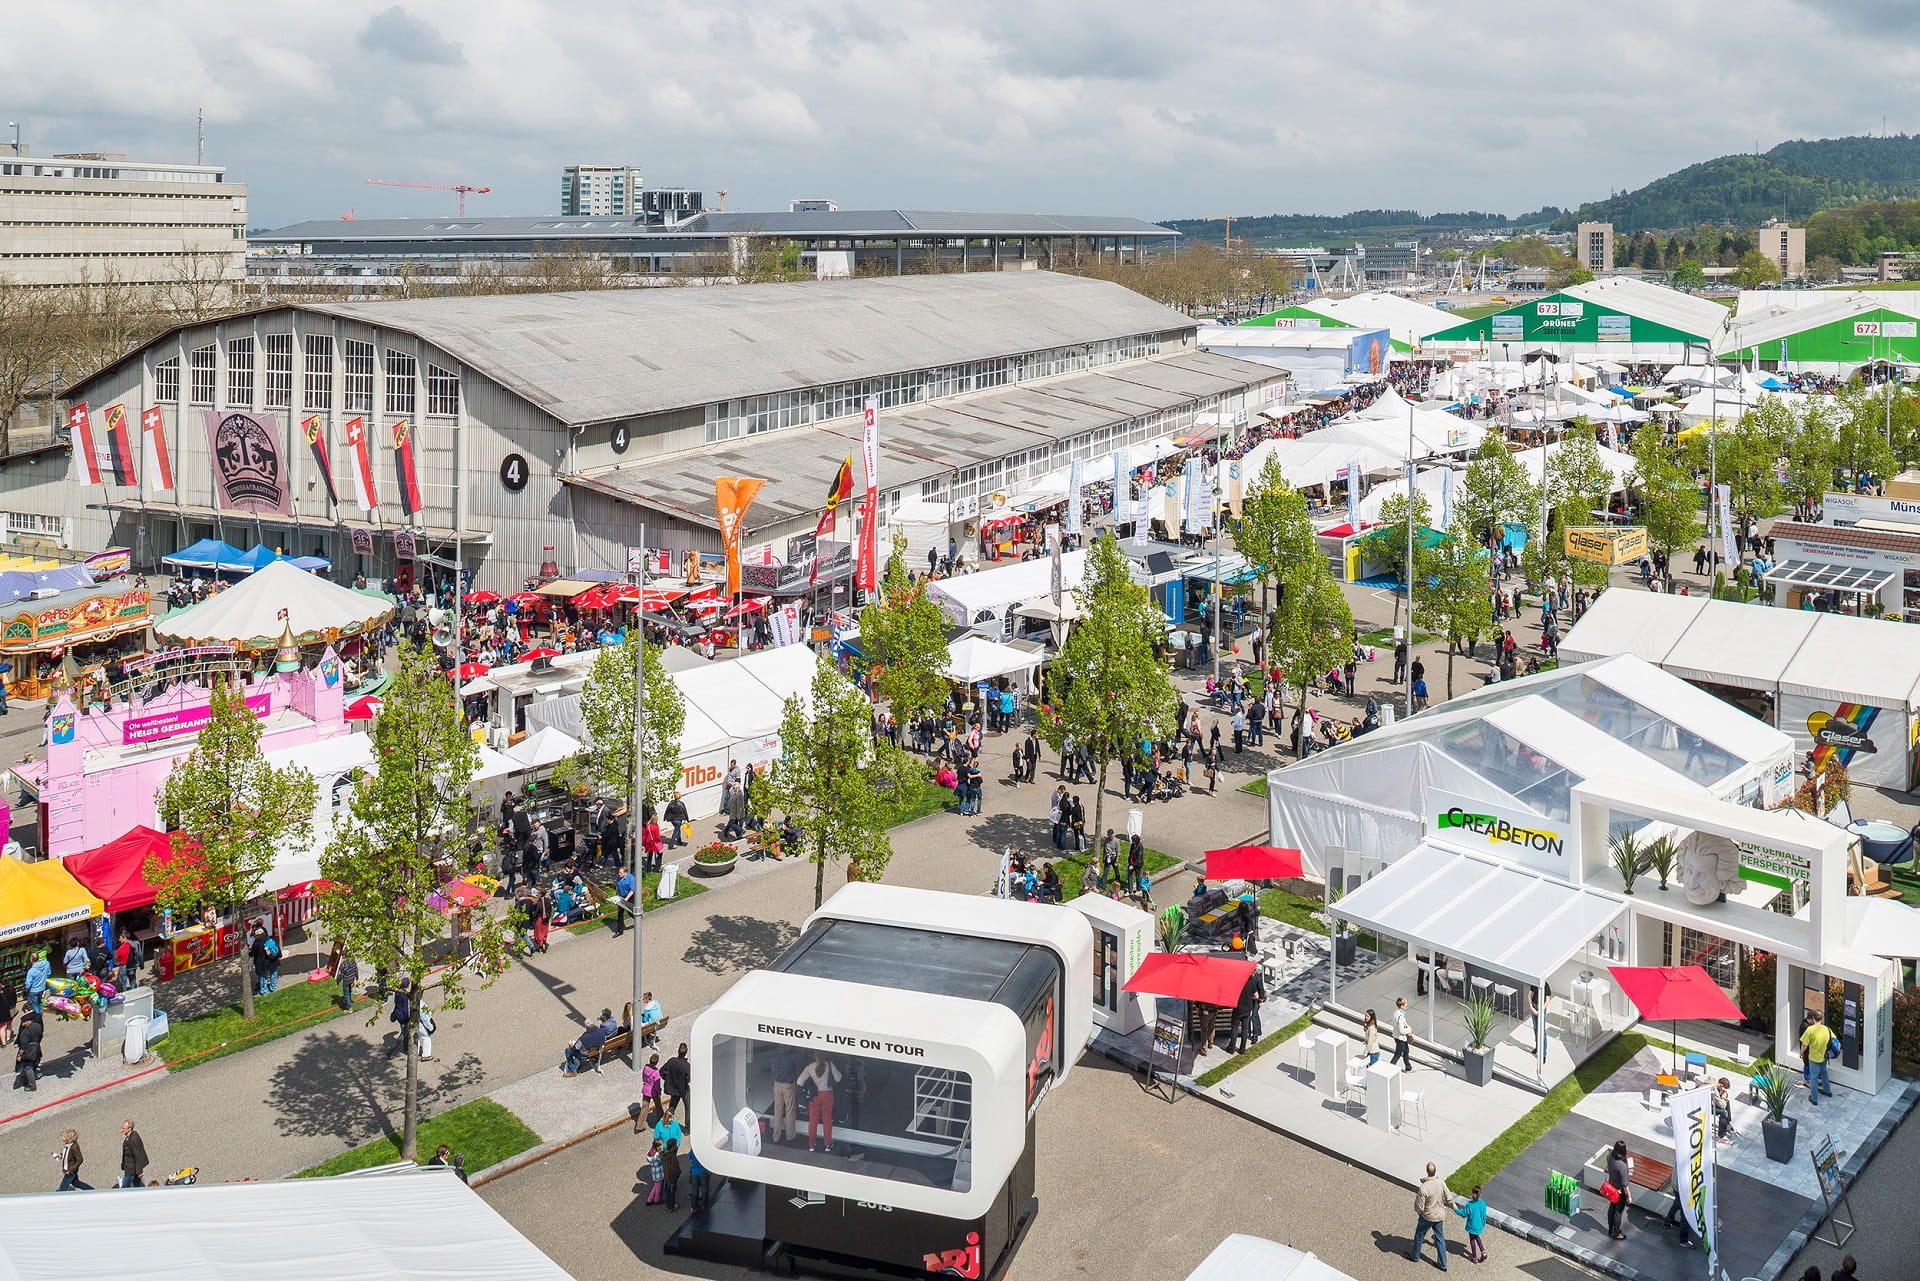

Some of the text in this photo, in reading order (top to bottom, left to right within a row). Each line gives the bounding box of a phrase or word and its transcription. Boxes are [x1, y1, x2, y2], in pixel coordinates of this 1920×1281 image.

[1538, 304, 1558, 314] 673
[1277, 319, 1293, 328] 671
[1543, 318, 1577, 328] GRÜNES
[1856, 323, 1878, 334] 672
[615, 428, 626, 447] 4
[507, 459, 521, 483] 4
[1825, 497, 1854, 506] WIGASOL
[1569, 532, 1608, 552] Glaser
[1802, 547, 1834, 556] GEMEINSAM
[1884, 554, 1911, 563] WIGASOL
[129, 716, 179, 730] Die weltbesten!
[129, 728, 159, 739] HEISS
[1820, 730, 1866, 745] Glaser
[682, 764, 723, 788] Tiba.
[1447, 807, 1564, 856] CREABETON
[1762, 846, 1804, 863] GENIALE
[757, 1023, 813, 1040] ENERGY
[826, 1033, 856, 1048] LIVE
[860, 1039, 881, 1051] ON
[885, 1042, 925, 1057] TOUR
